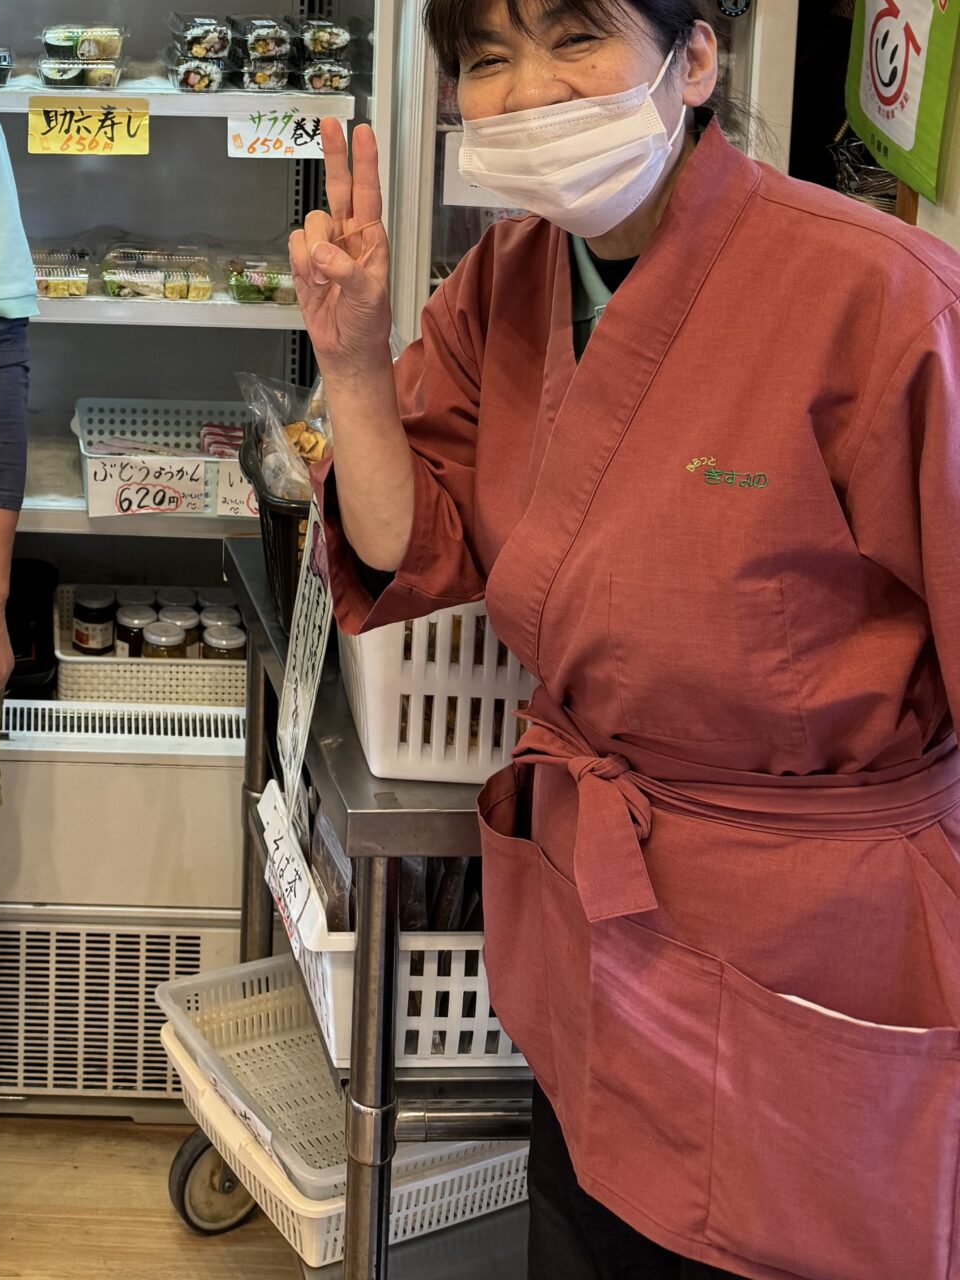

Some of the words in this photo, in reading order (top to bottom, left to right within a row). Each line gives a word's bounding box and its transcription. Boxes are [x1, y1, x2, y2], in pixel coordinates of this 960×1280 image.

[41, 106, 143, 142] 助六寿し
[119, 487, 179, 512] 620円
